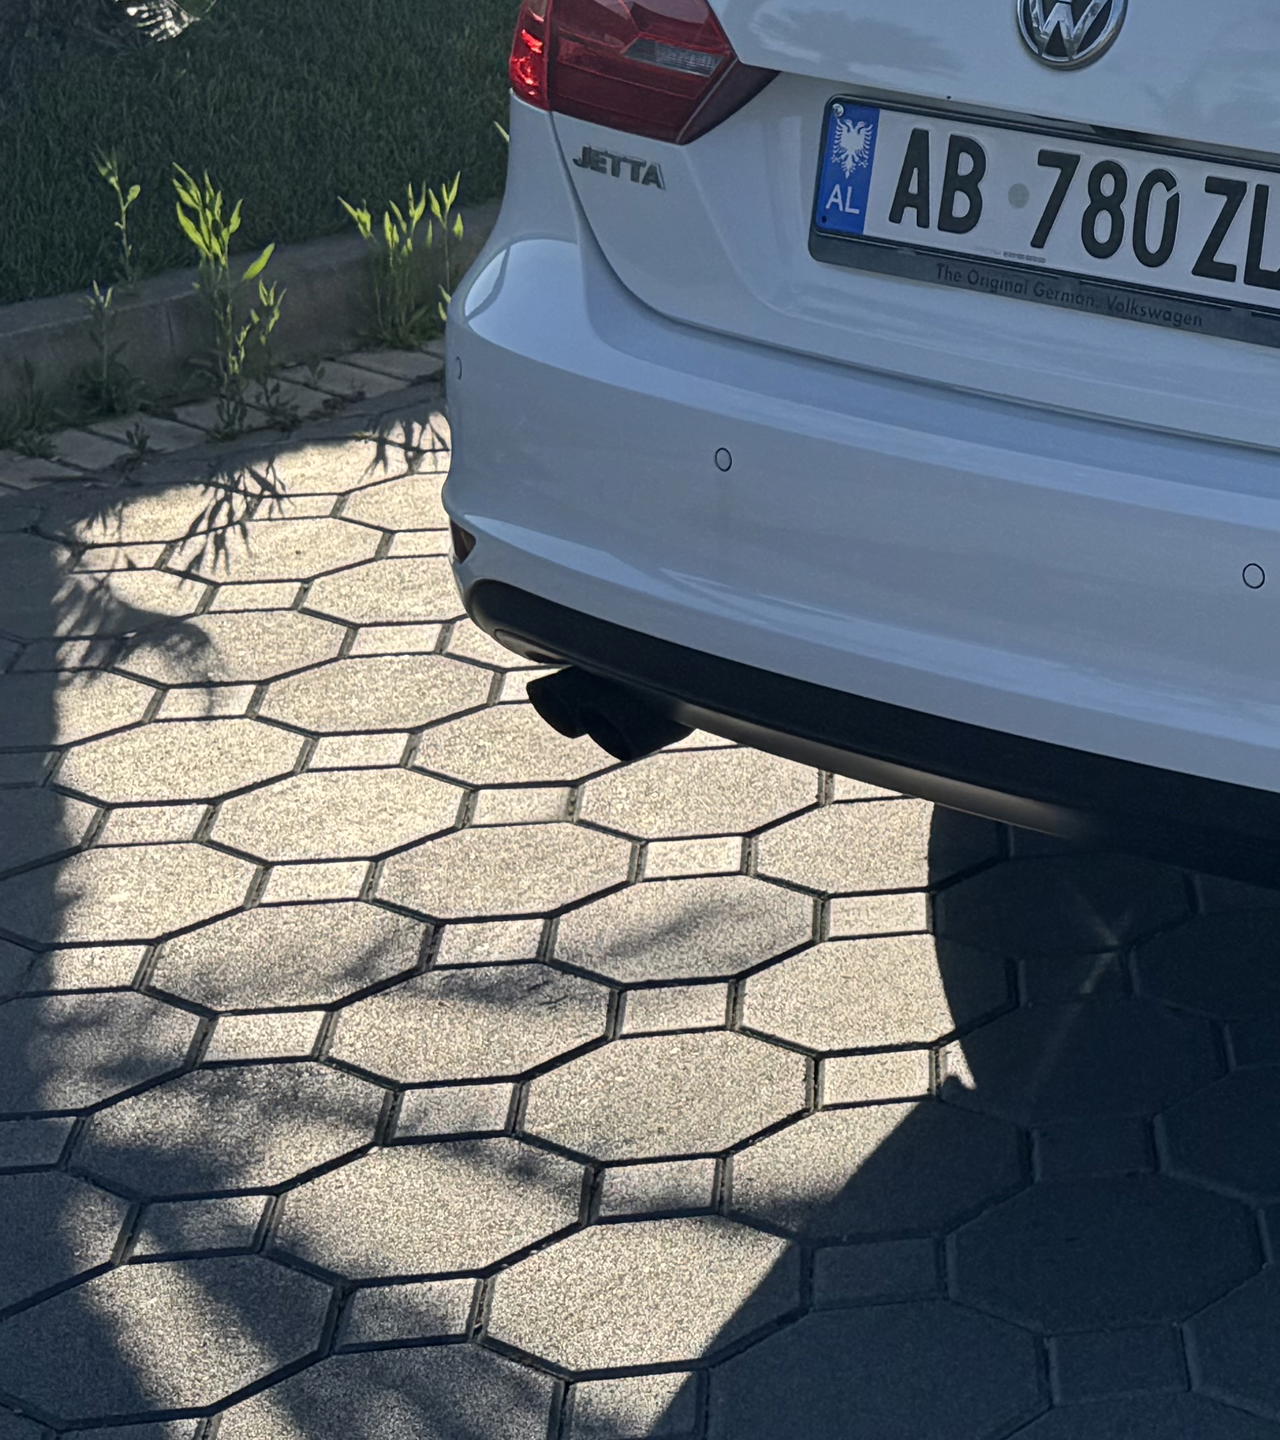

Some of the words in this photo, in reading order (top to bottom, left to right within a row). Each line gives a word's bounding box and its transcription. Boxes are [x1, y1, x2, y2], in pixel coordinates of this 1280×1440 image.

[572, 145, 666, 191] JETTA
[825, 184, 860, 215] AL
[888, 127, 987, 235] AB
[1030, 148, 1181, 268] 780
[935, 262, 963, 283] The
[967, 267, 1029, 297] Original
[1106, 294, 1204, 329] Volkswagen
